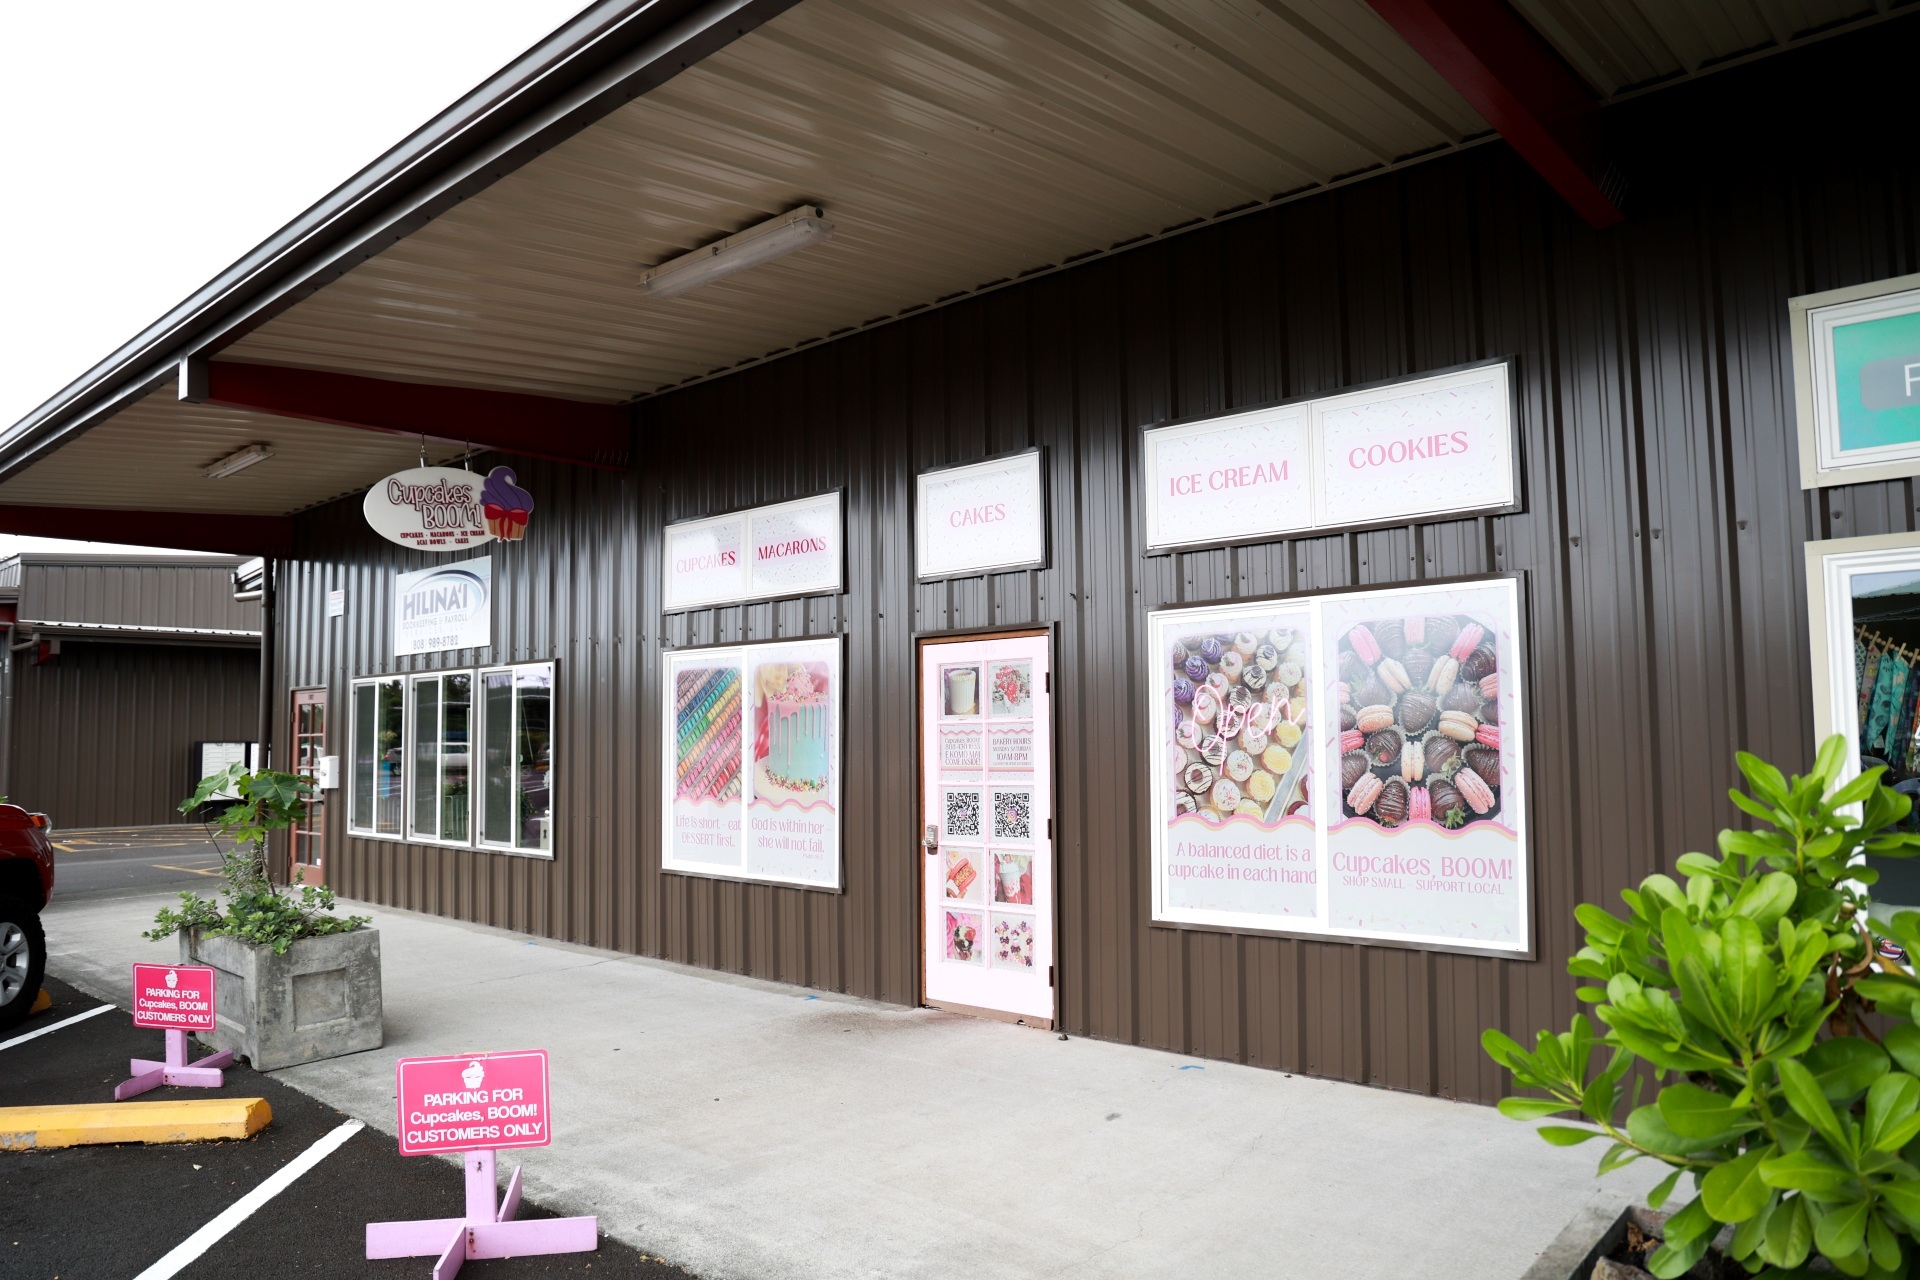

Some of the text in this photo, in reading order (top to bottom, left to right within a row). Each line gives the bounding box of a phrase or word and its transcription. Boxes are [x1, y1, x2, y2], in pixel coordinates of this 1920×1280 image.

[1348, 430, 1469, 470] COOKIES
[1170, 460, 1289, 497] ICE CREAM
[387, 478, 473, 511] Cupcakes
[422, 503, 483, 529] BOOM!
[949, 503, 1006, 528] CAKES
[757, 535, 827, 561] MACARONS
[676, 550, 736, 574] CUPCAKES
[402, 617, 437, 630] BOOKKEEPING
[445, 613, 468, 624] PAYROLL
[428, 635, 459, 648] 989-8782
[1191, 684, 1306, 776] Open
[675, 814, 742, 831] Life is short eat
[751, 817, 824, 835] God is within her
[682, 831, 736, 848] DESSERT first.
[757, 835, 825, 853] she will not fail.
[1175, 842, 1311, 862] A balanced diet is a
[1168, 863, 1317, 884] cupcake in each hand
[1332, 851, 1513, 880] Cupcakes, BOOM!
[1342, 875, 1505, 895] SHOP SMALL SUPPORT LOCAL
[145, 988, 200, 999] PARKING FOR
[139, 998, 208, 1011] Cupcakes, BOOM!
[137, 1010, 211, 1024] CUSTOMERS ONLY
[423, 1088, 523, 1107] PARKING FOR
[410, 1103, 538, 1127] Cupcakes, BOOM!
[407, 1122, 543, 1144] CUSTOMERS ONLY
